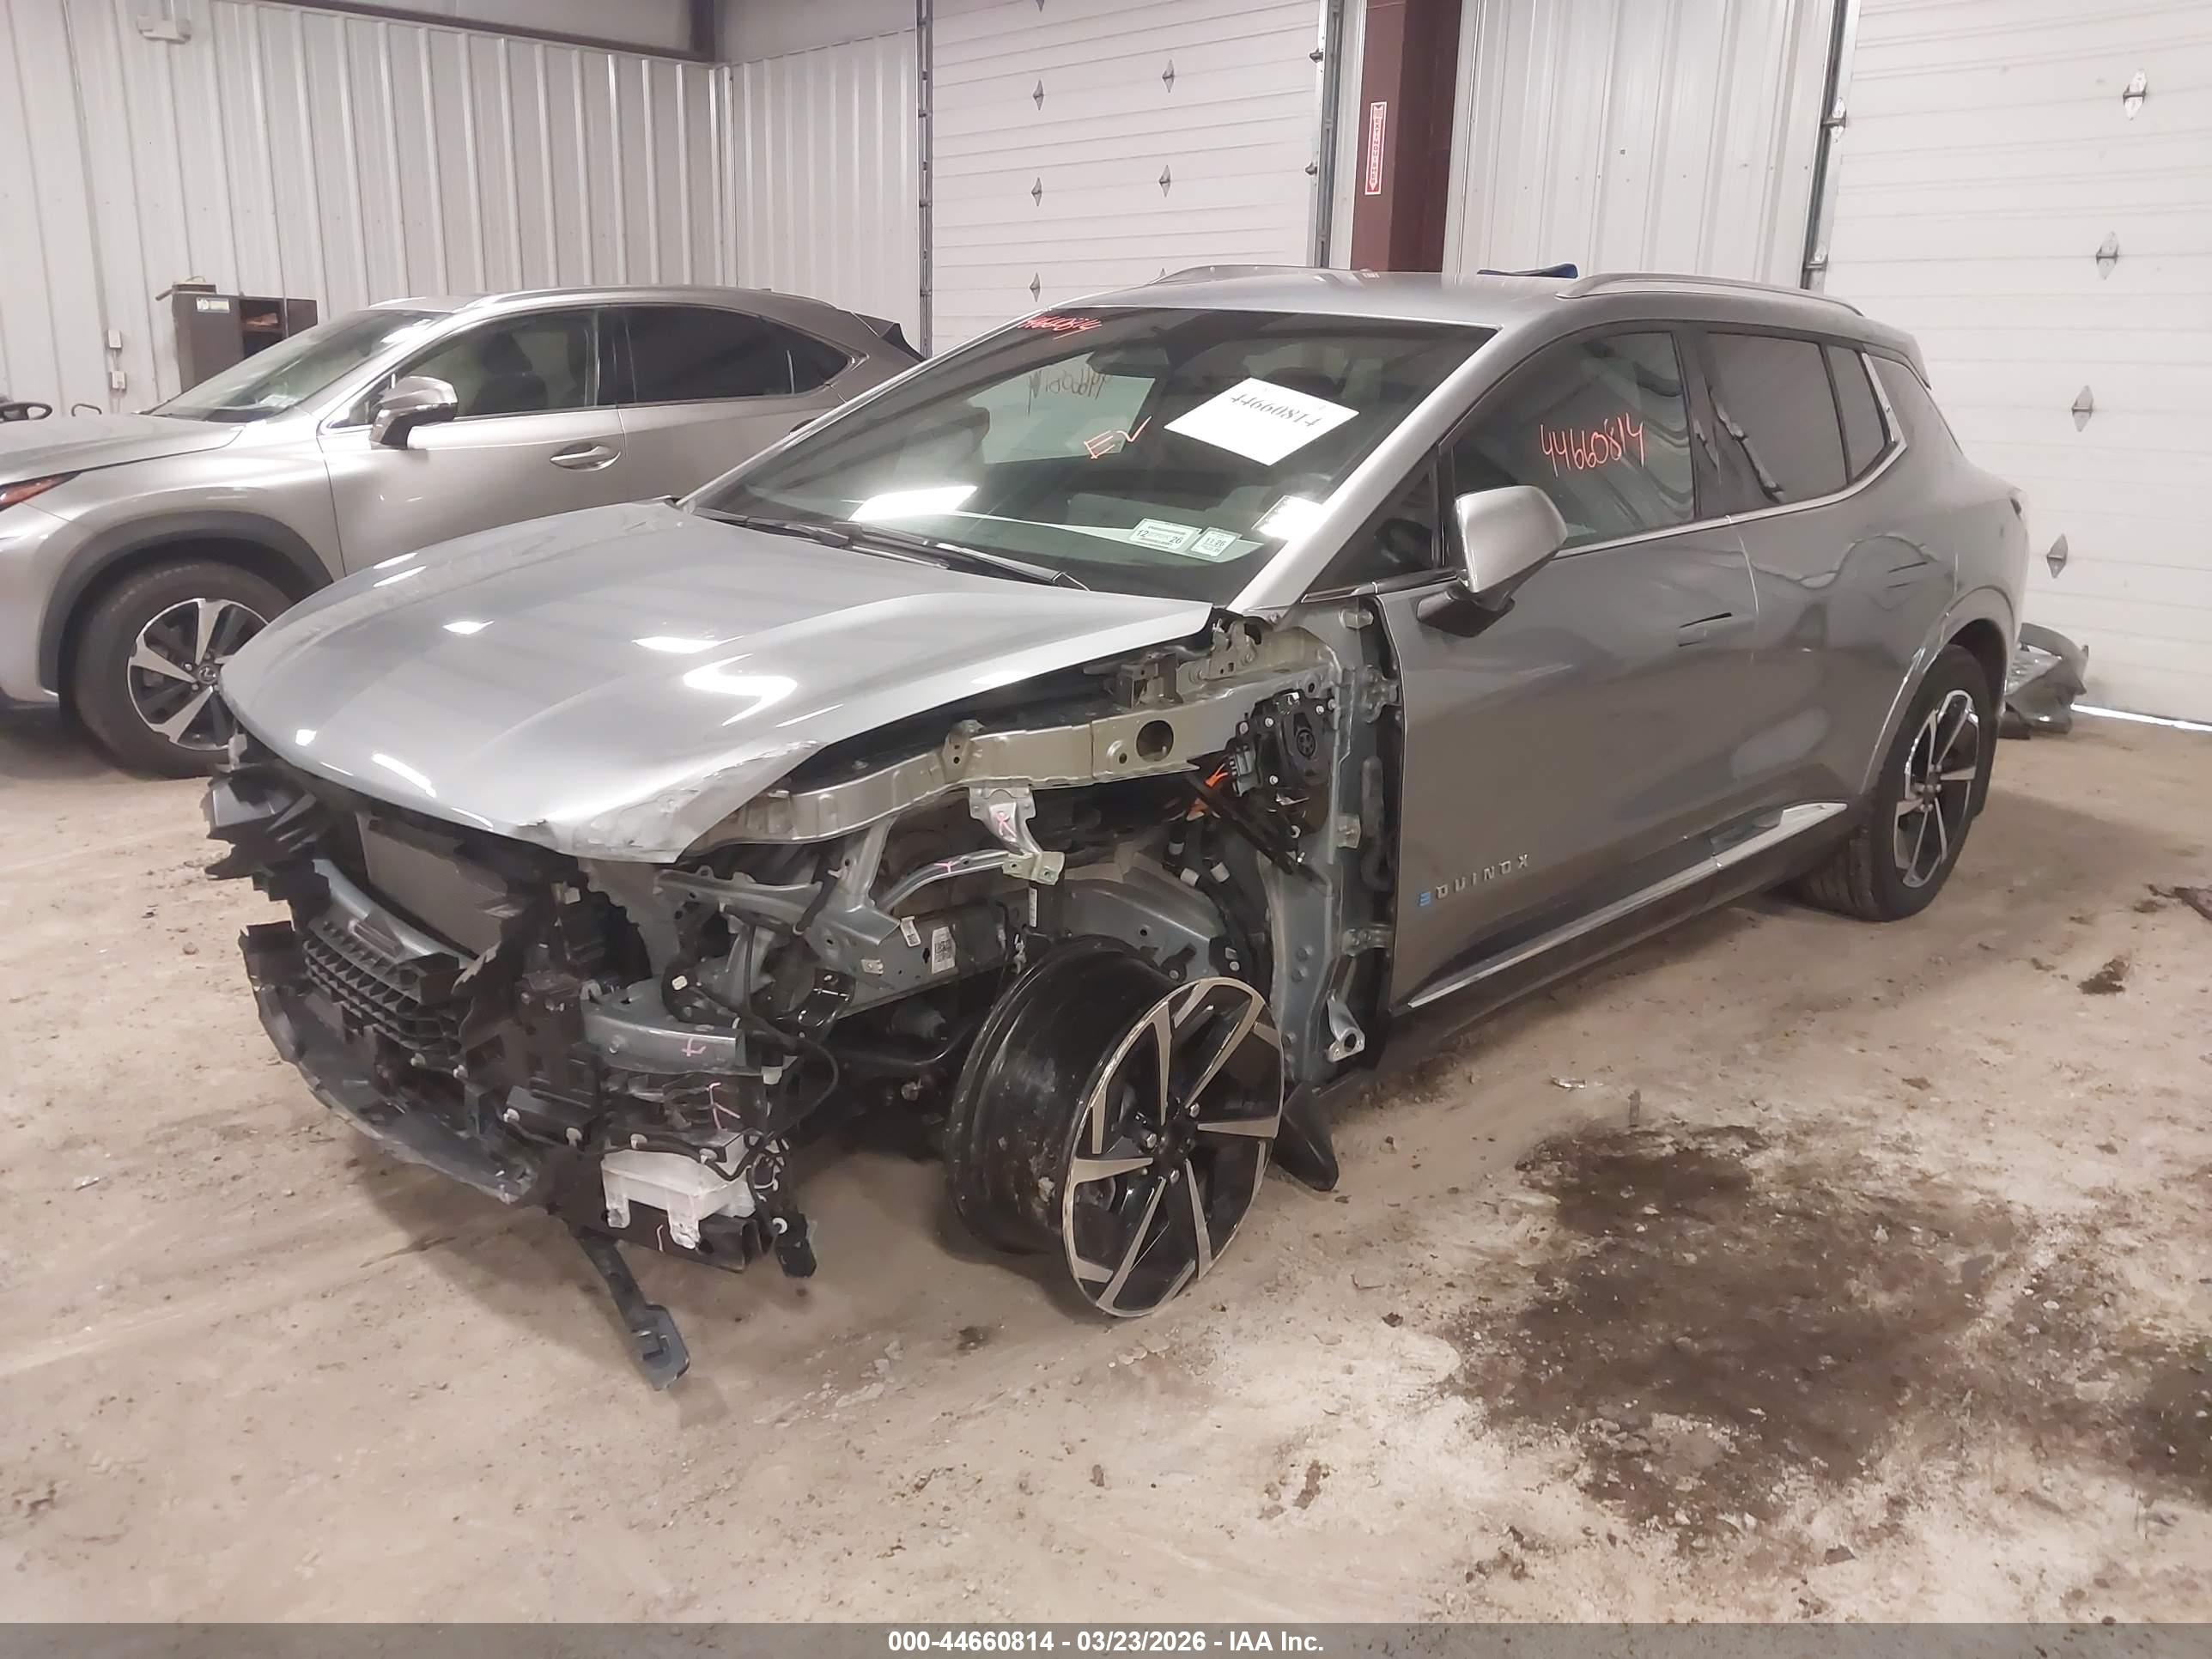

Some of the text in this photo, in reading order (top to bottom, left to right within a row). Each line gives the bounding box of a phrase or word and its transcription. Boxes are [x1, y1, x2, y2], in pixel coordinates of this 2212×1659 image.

[1231, 392, 1323, 428] 44660814
[1540, 412, 1645, 478] 44660814
[1136, 529, 1149, 538] 12
[1169, 536, 1183, 544] 26
[1417, 853, 1529, 907] EQUINOX
